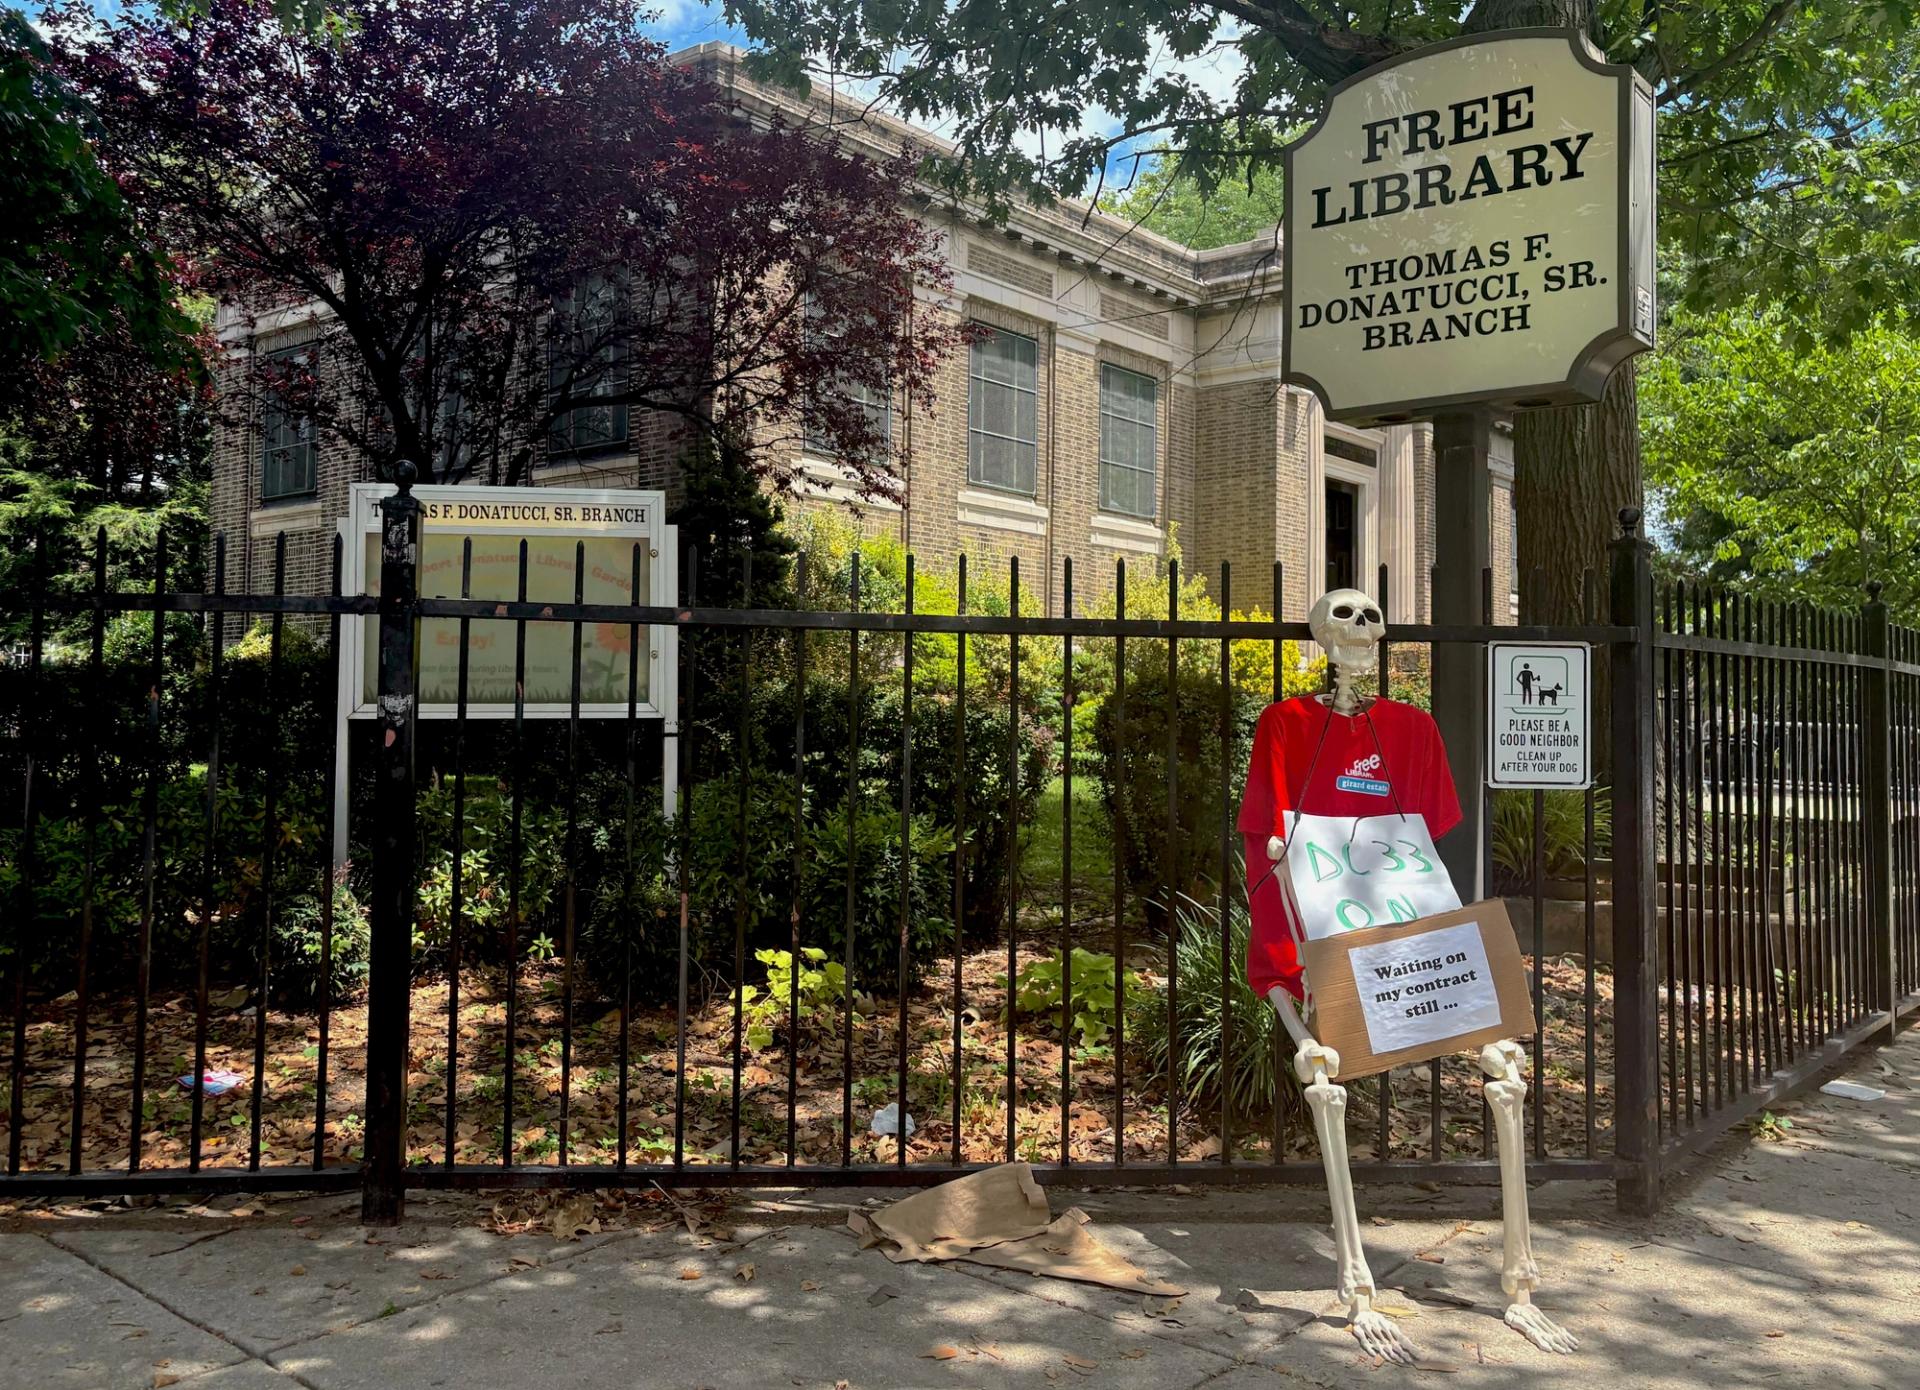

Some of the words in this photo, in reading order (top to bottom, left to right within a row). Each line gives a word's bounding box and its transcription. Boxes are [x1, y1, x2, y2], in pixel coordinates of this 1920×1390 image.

[1362, 85, 1534, 164] FREE
[1311, 132, 1594, 229] LIBRARY
[1345, 240, 1510, 289] THOMAS
[1523, 233, 1553, 262] F.
[1299, 272, 1530, 329] DONATUCCI,
[1543, 260, 1608, 293] SR.
[1362, 303, 1531, 351] BRANCH
[443, 504, 454, 519] F.
[458, 504, 550, 522] DONATUCCI,
[554, 506, 577, 521] SR.
[582, 507, 646, 523] BRANCH
[436, 630, 495, 649] Enoy!
[1509, 719, 1545, 732] PLEASE
[1548, 719, 1560, 732] BE
[1563, 720, 1570, 733] A
[1500, 733, 1526, 746] GOOD
[1530, 734, 1579, 747] NEIGHBOR
[1353, 753, 1381, 772] Free
[1517, 751, 1546, 761] CLEAN
[1549, 751, 1562, 762] UP
[1500, 762, 1528, 772] AFTER
[1532, 762, 1556, 773] YOUR
[1559, 763, 1578, 773] DOG
[1341, 779, 1366, 790] girard
[1335, 893, 1418, 929] ON
[1374, 957, 1443, 980] Waiting
[1446, 951, 1467, 964] on
[1375, 988, 1401, 1003] my
[1406, 969, 1478, 996] contract
[1405, 1000, 1440, 1018] still
